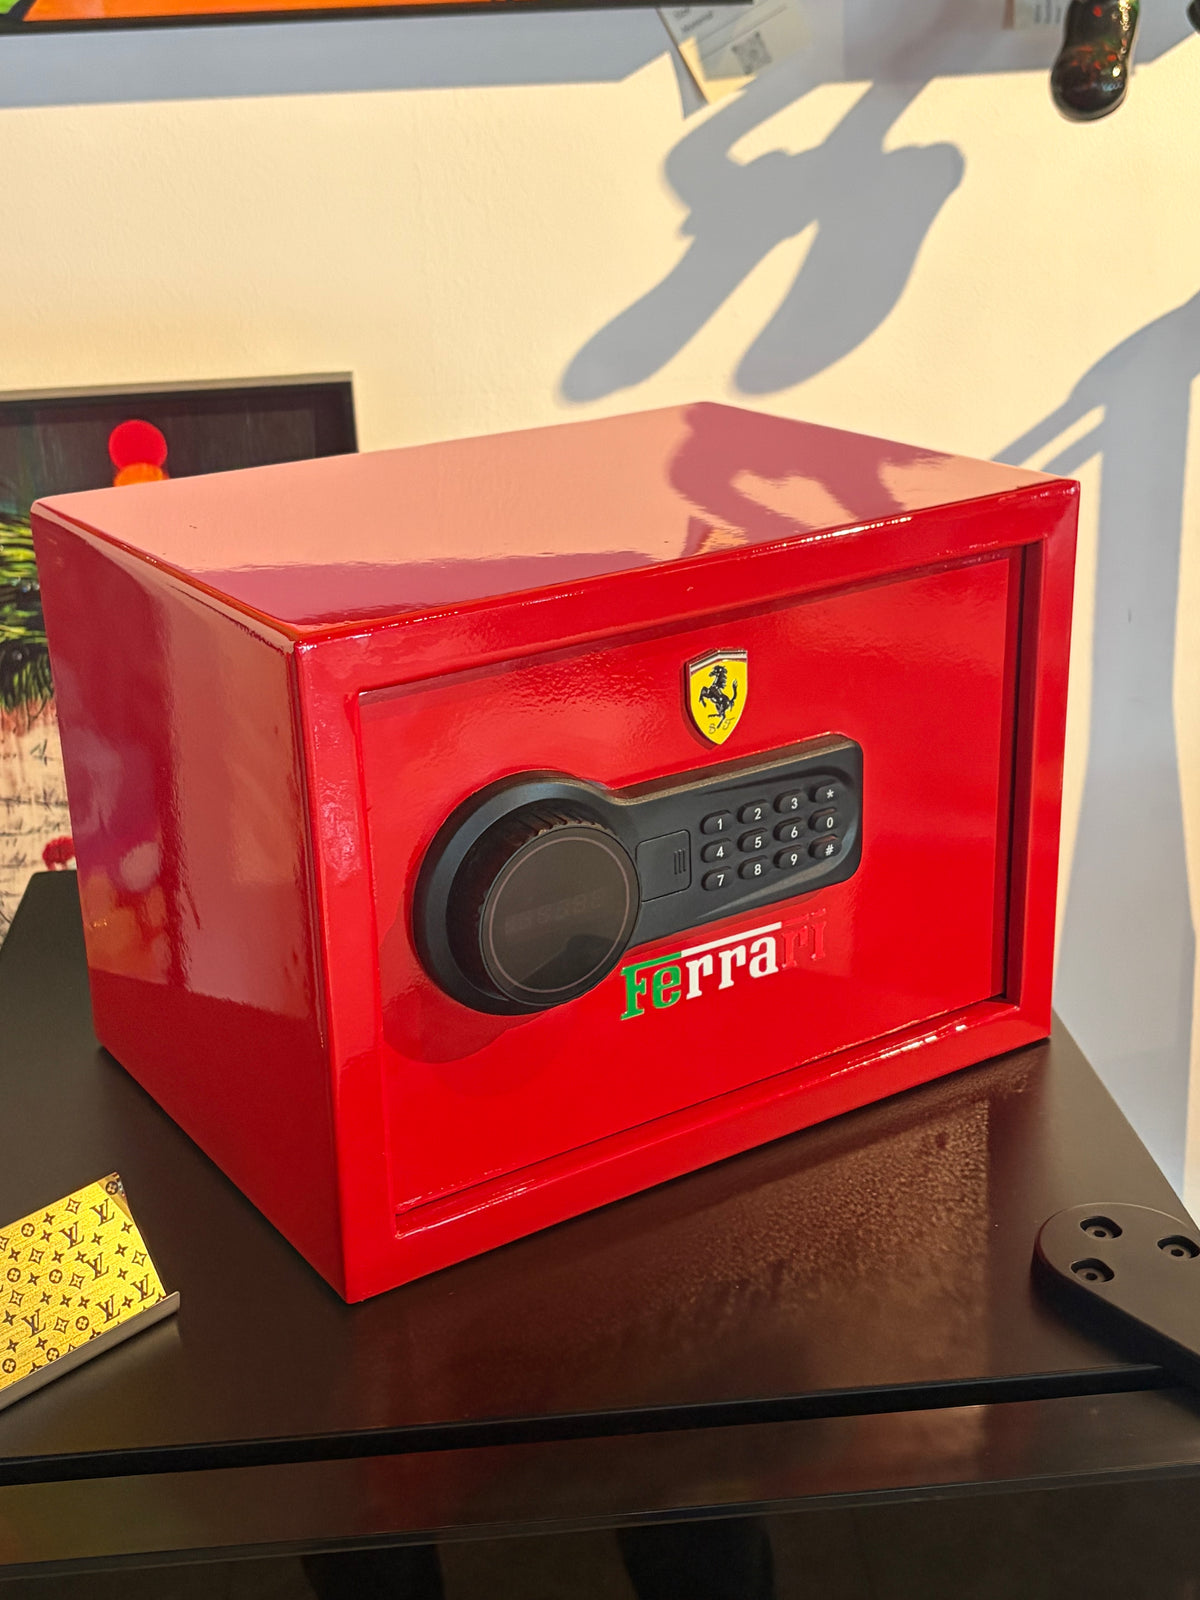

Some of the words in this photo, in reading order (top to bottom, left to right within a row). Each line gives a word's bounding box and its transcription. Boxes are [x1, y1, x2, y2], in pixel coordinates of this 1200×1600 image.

[716, 818, 724, 831] 1
[753, 807, 762, 821] 2
[790, 797, 799, 810] 3
[716, 846, 725, 858] 4
[754, 836, 763, 849] 5
[790, 826, 799, 839] 6
[716, 874, 725, 887] 7
[753, 863, 762, 876] 8
[790, 853, 798, 866] 9
[620, 908, 827, 1021] Ferrari
